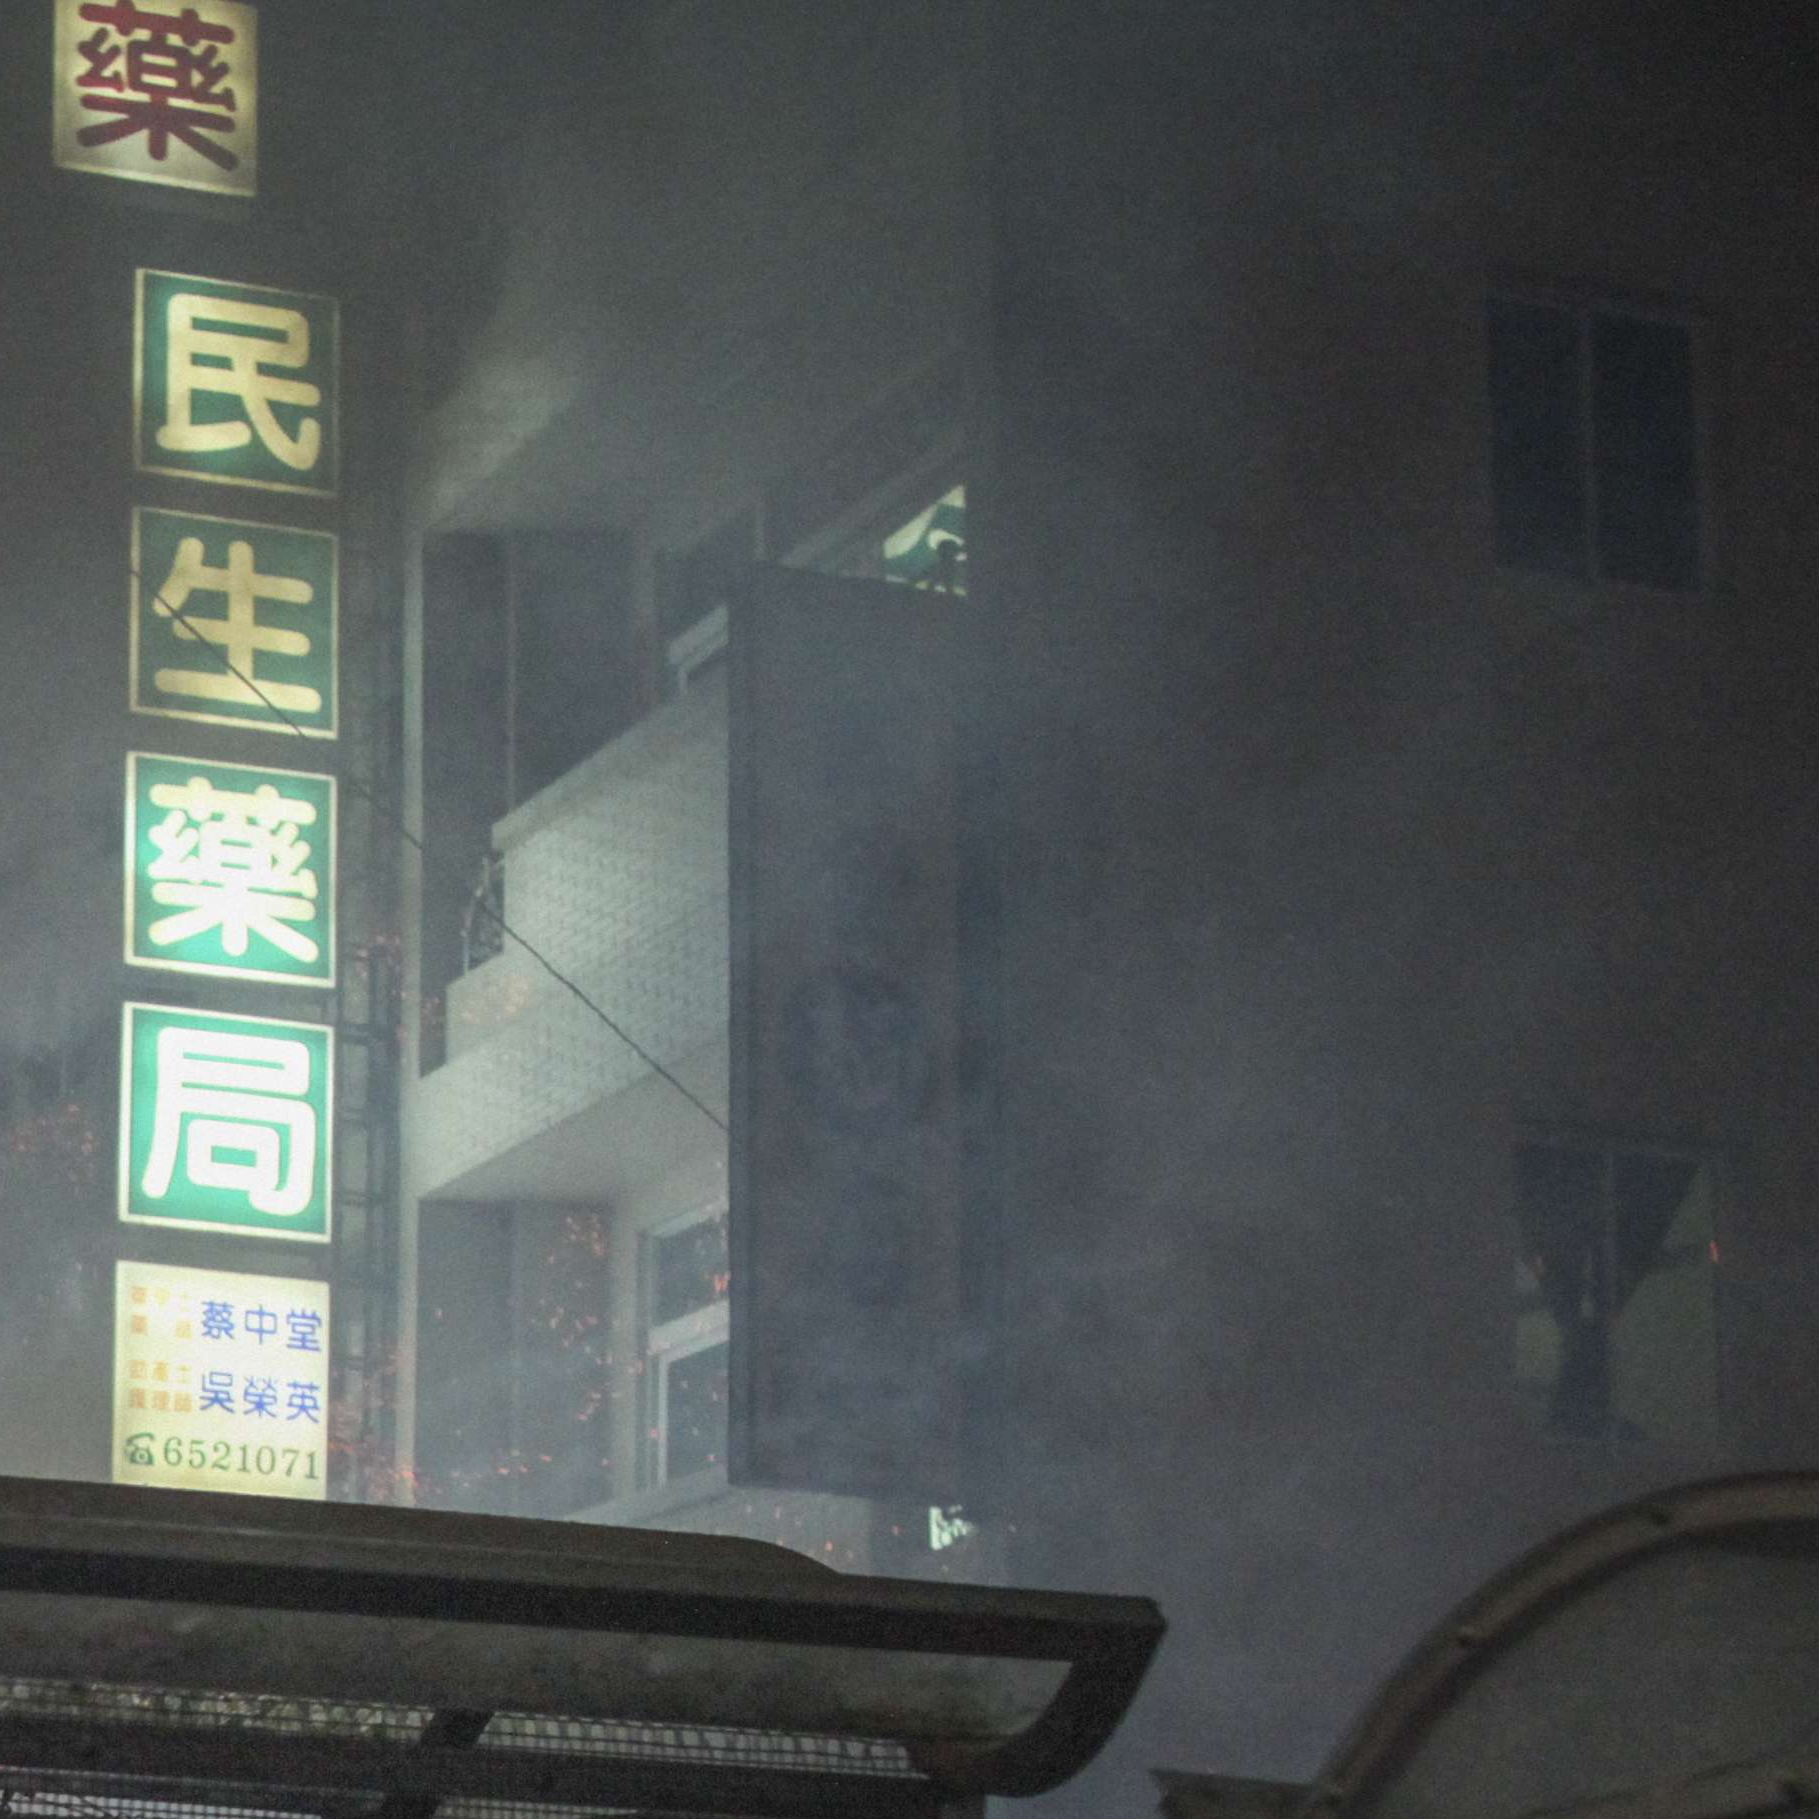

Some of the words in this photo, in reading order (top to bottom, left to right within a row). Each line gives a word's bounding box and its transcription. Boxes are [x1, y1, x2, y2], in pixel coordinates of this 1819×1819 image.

[76, 0, 240, 172] 藥
[142, 292, 323, 1218] 民生藥局
[200, 1300, 322, 1352] 蔡中堂
[199, 1371, 321, 1424] 吳榮英
[163, 1436, 320, 1481] 6521071
